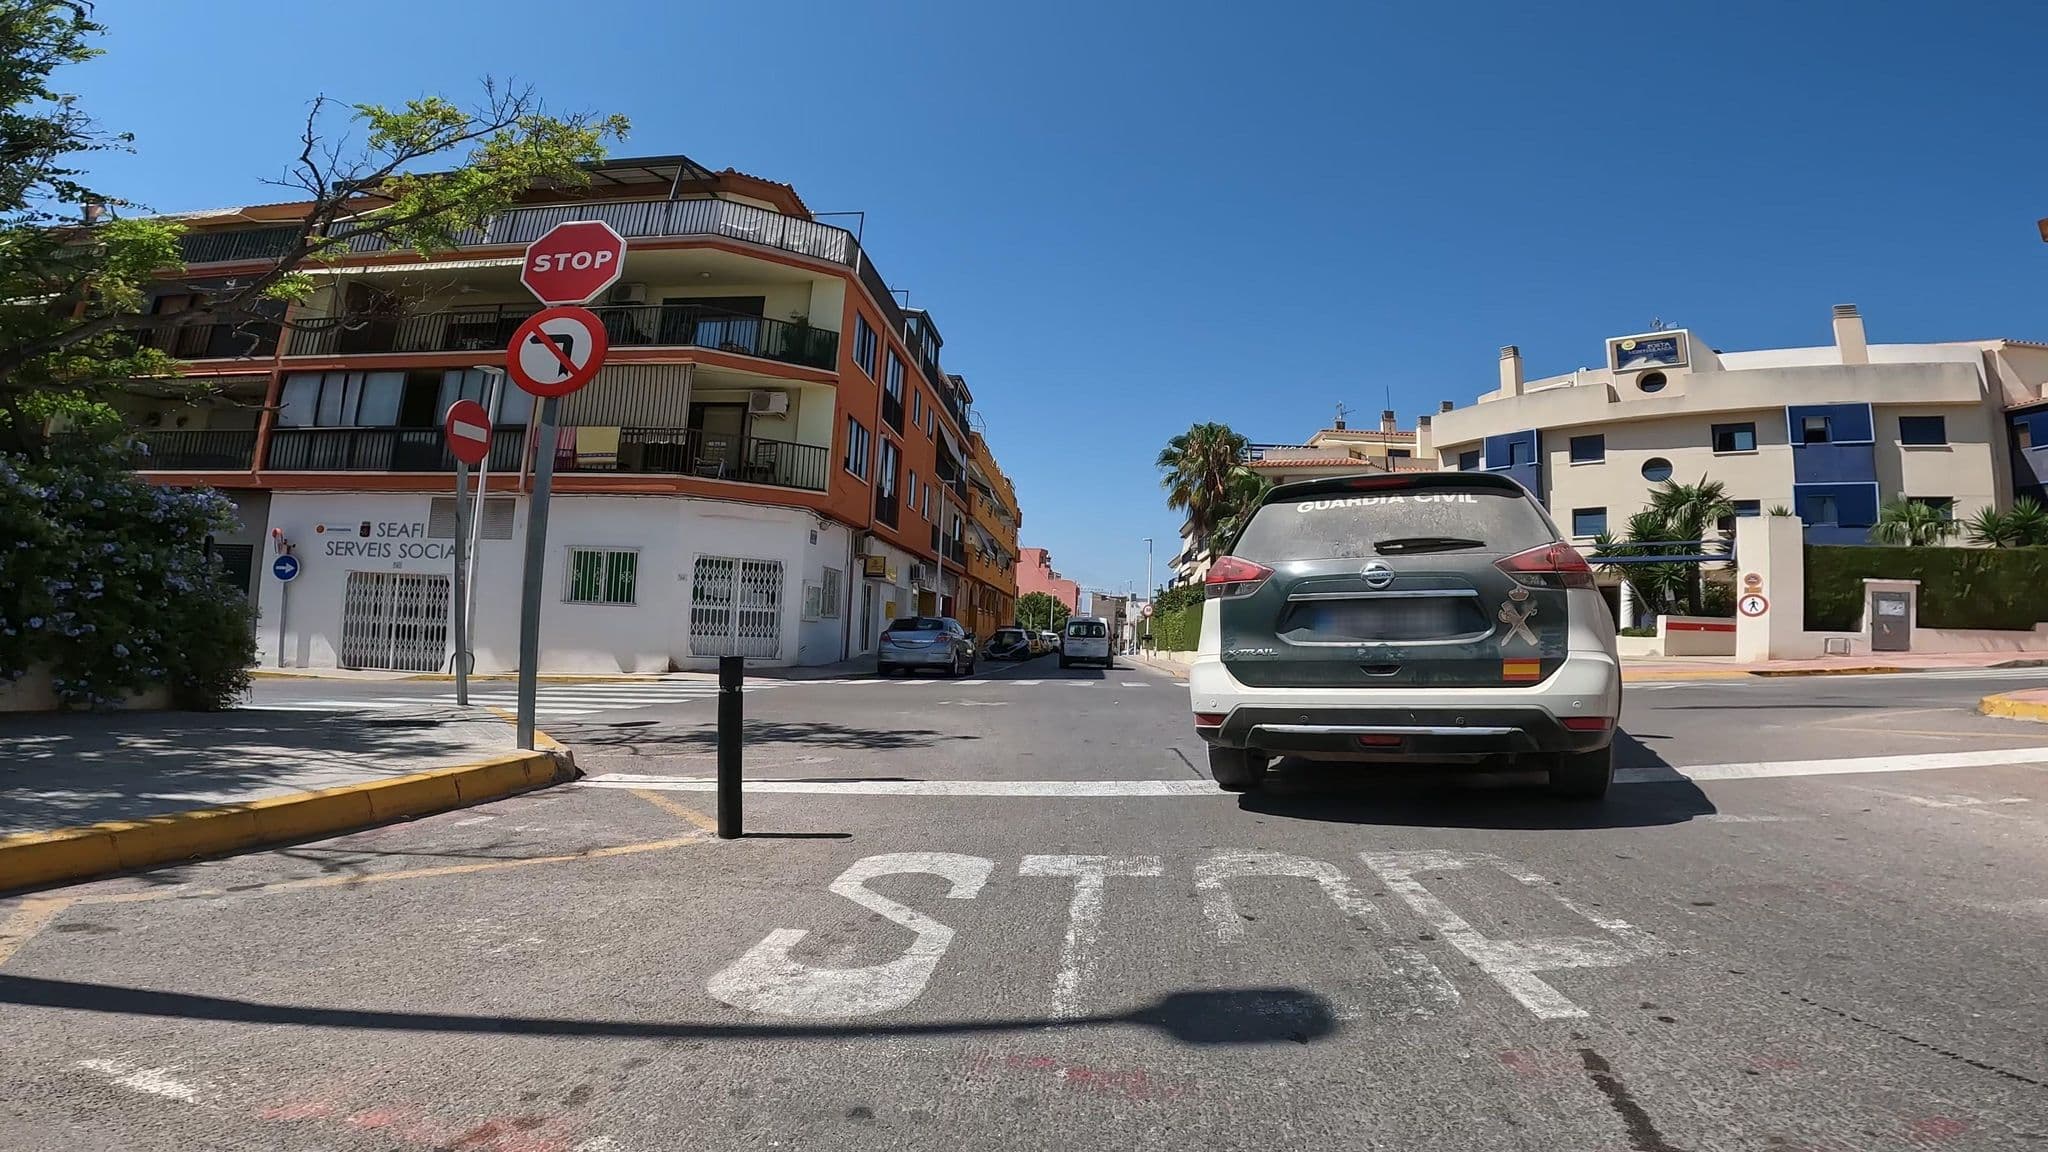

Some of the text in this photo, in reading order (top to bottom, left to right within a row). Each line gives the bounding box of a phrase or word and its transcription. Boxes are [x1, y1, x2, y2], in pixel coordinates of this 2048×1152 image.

[533, 250, 613, 273] STOP
[1297, 494, 1478, 513] GUARDIA CIVIL
[376, 522, 425, 538] SEAFI
[325, 541, 391, 558] SERVEIS
[1225, 648, 1279, 657] X-TRAIL
[706, 851, 1672, 1020] STOP
